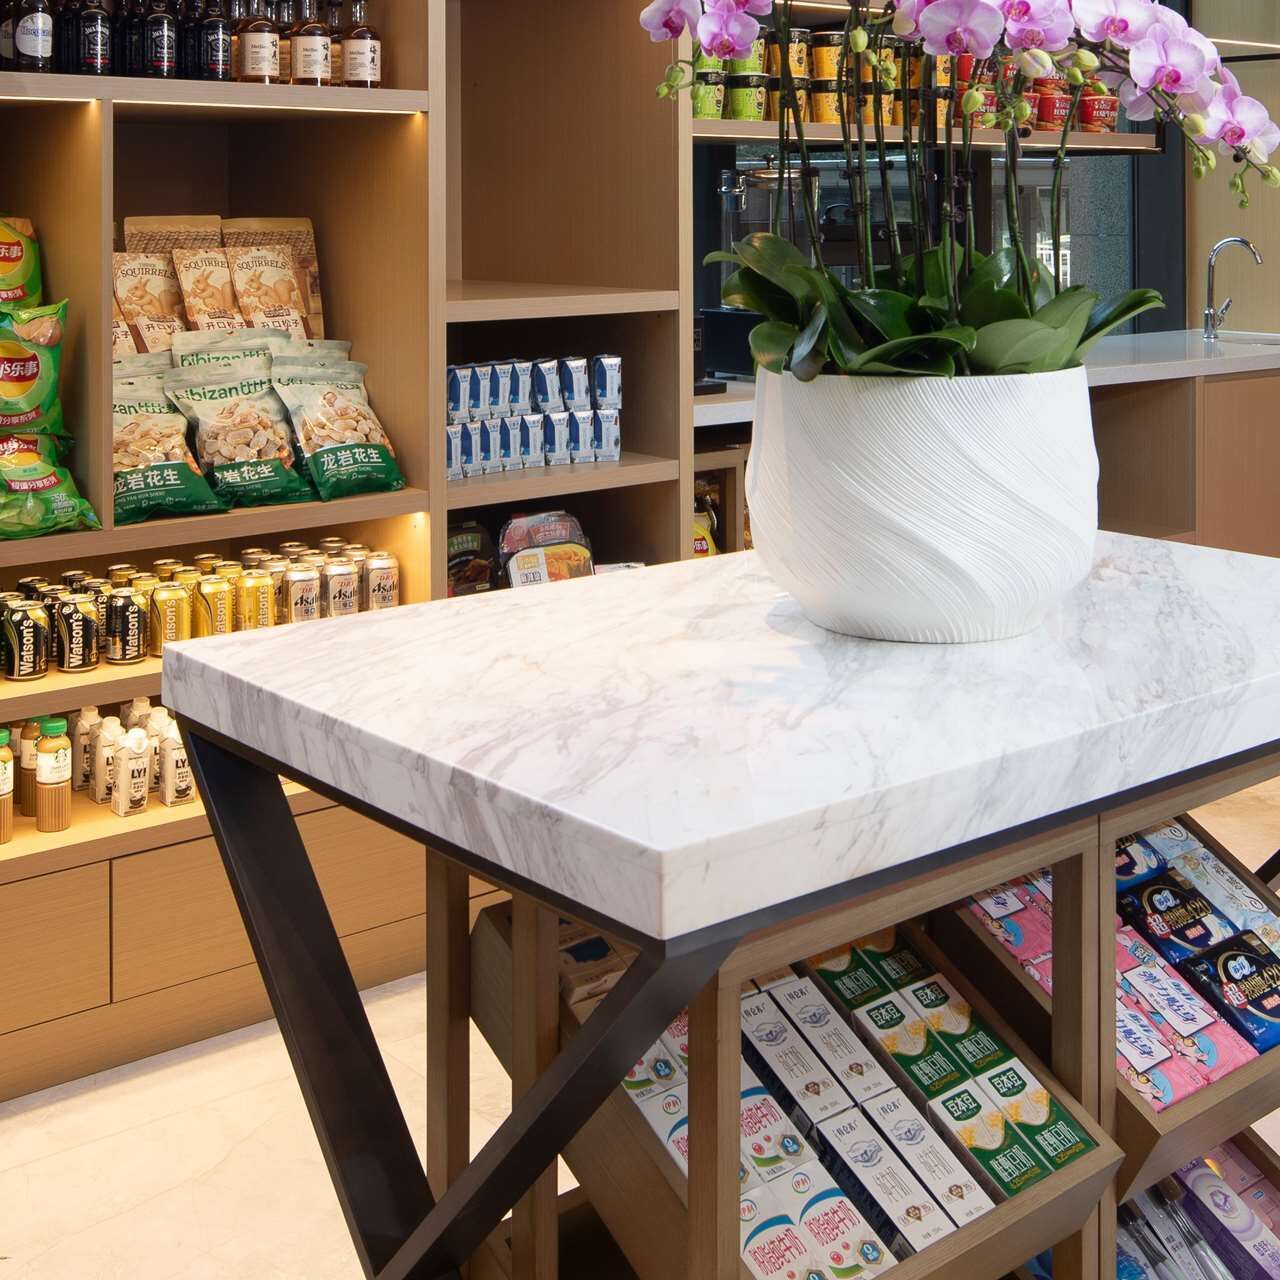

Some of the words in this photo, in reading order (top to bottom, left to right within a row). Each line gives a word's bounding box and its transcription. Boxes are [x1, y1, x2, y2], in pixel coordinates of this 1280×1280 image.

[183, 259, 228, 273] SQUIRRE
[236, 258, 288, 272] SQUIRRELS
[320, 447, 383, 471] 龙岩花生
[166, 599, 176, 640] atson's
[217, 591, 226, 633] atson's
[259, 585, 269, 627] atson's
[20, 619, 34, 675] Watson's
[69, 612, 83, 668] Watson's
[125, 604, 138, 659] Watson's
[131, 767, 147, 779] LY!
[915, 982, 946, 1005] 豆本豆
[871, 1003, 902, 1026] 豆本豆
[991, 1070, 1023, 1094] 豆本豆
[945, 1092, 977, 1117] 豆本豆
[804, 1199, 861, 1247] 脱脂纯牛奶
[748, 1226, 808, 1276] 脱脂纯牛奶
